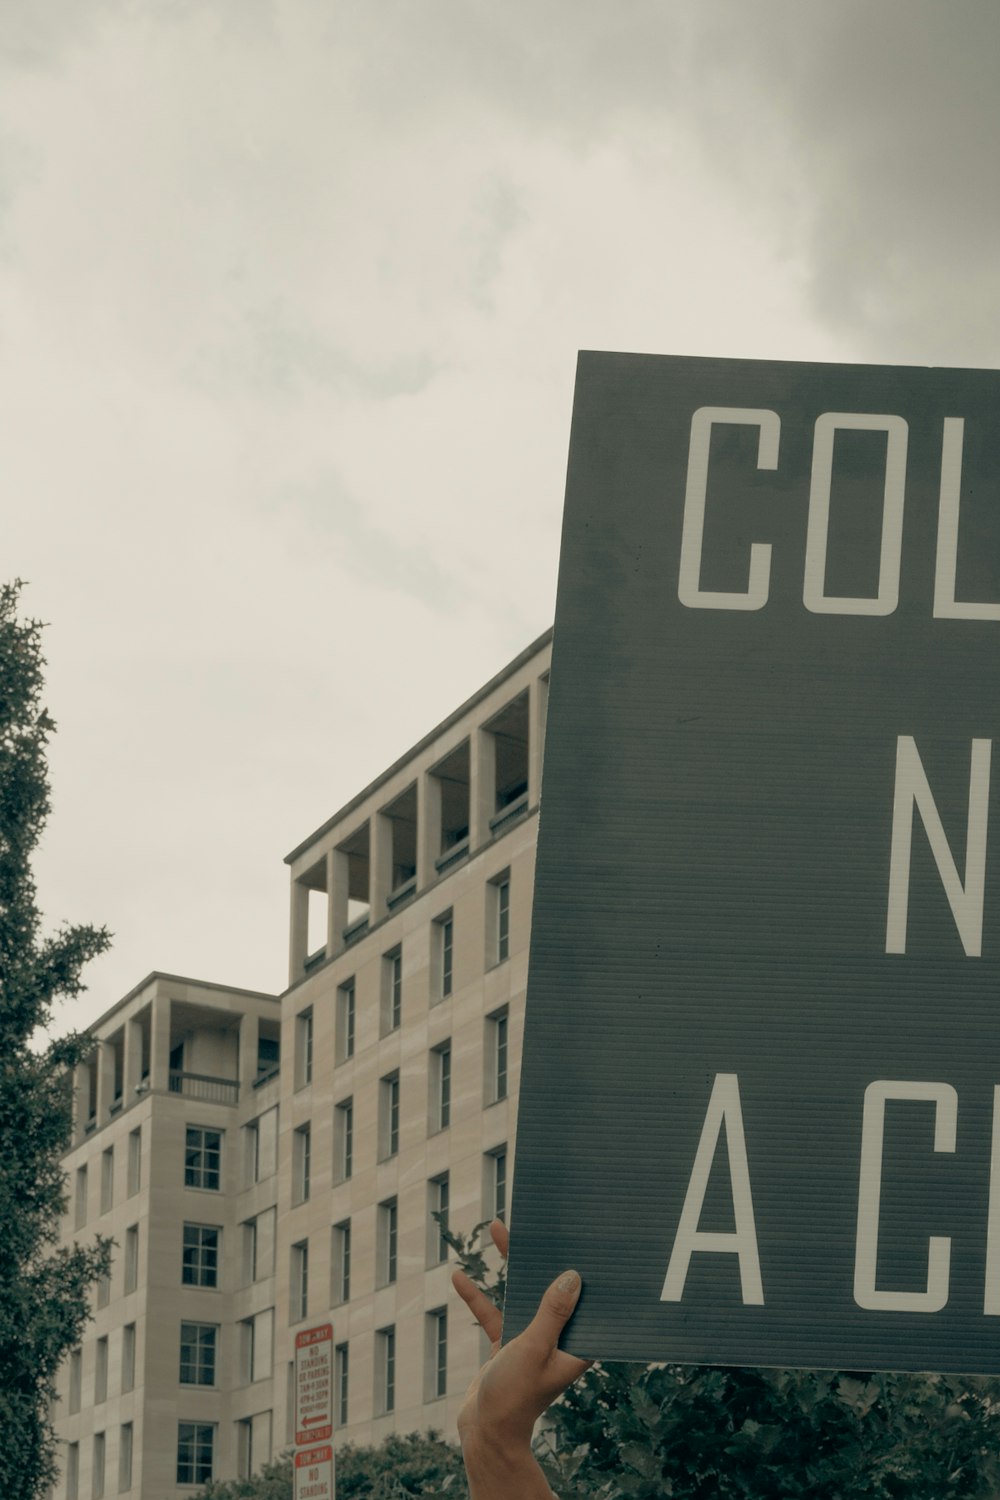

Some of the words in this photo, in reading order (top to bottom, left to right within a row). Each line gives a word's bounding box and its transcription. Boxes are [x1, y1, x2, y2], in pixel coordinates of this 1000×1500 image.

[660, 1073, 764, 1305] A
[309, 1346, 320, 1357] NO
[301, 1354, 328, 1371] STANDING
[307, 1367, 330, 1380] PARKING
[309, 1467, 319, 1481] NO
[300, 1482, 328, 1499] STANDING
